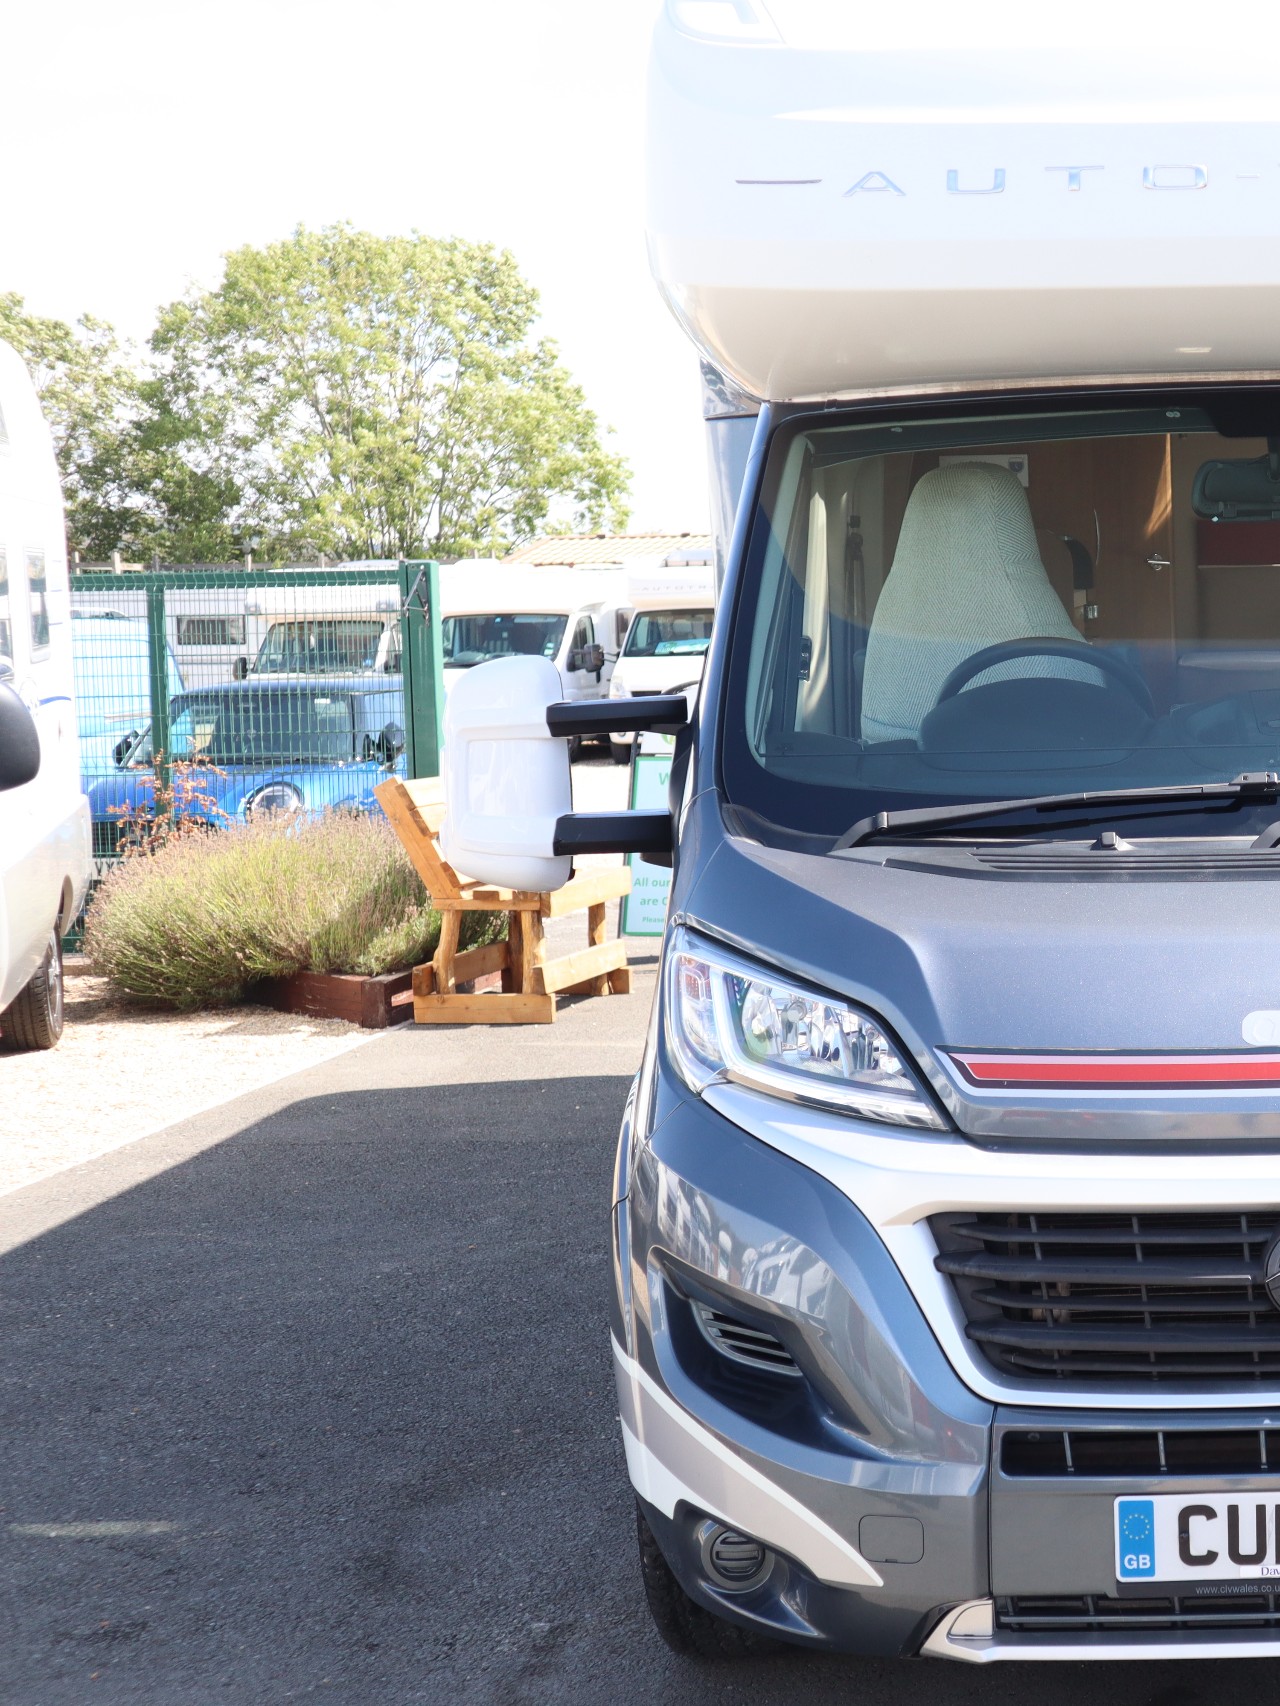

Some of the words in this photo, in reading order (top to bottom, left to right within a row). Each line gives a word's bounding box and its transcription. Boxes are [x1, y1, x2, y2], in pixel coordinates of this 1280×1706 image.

[633, 877, 649, 887] All
[640, 898, 659, 906] are
[1124, 1554, 1151, 1570] GB
